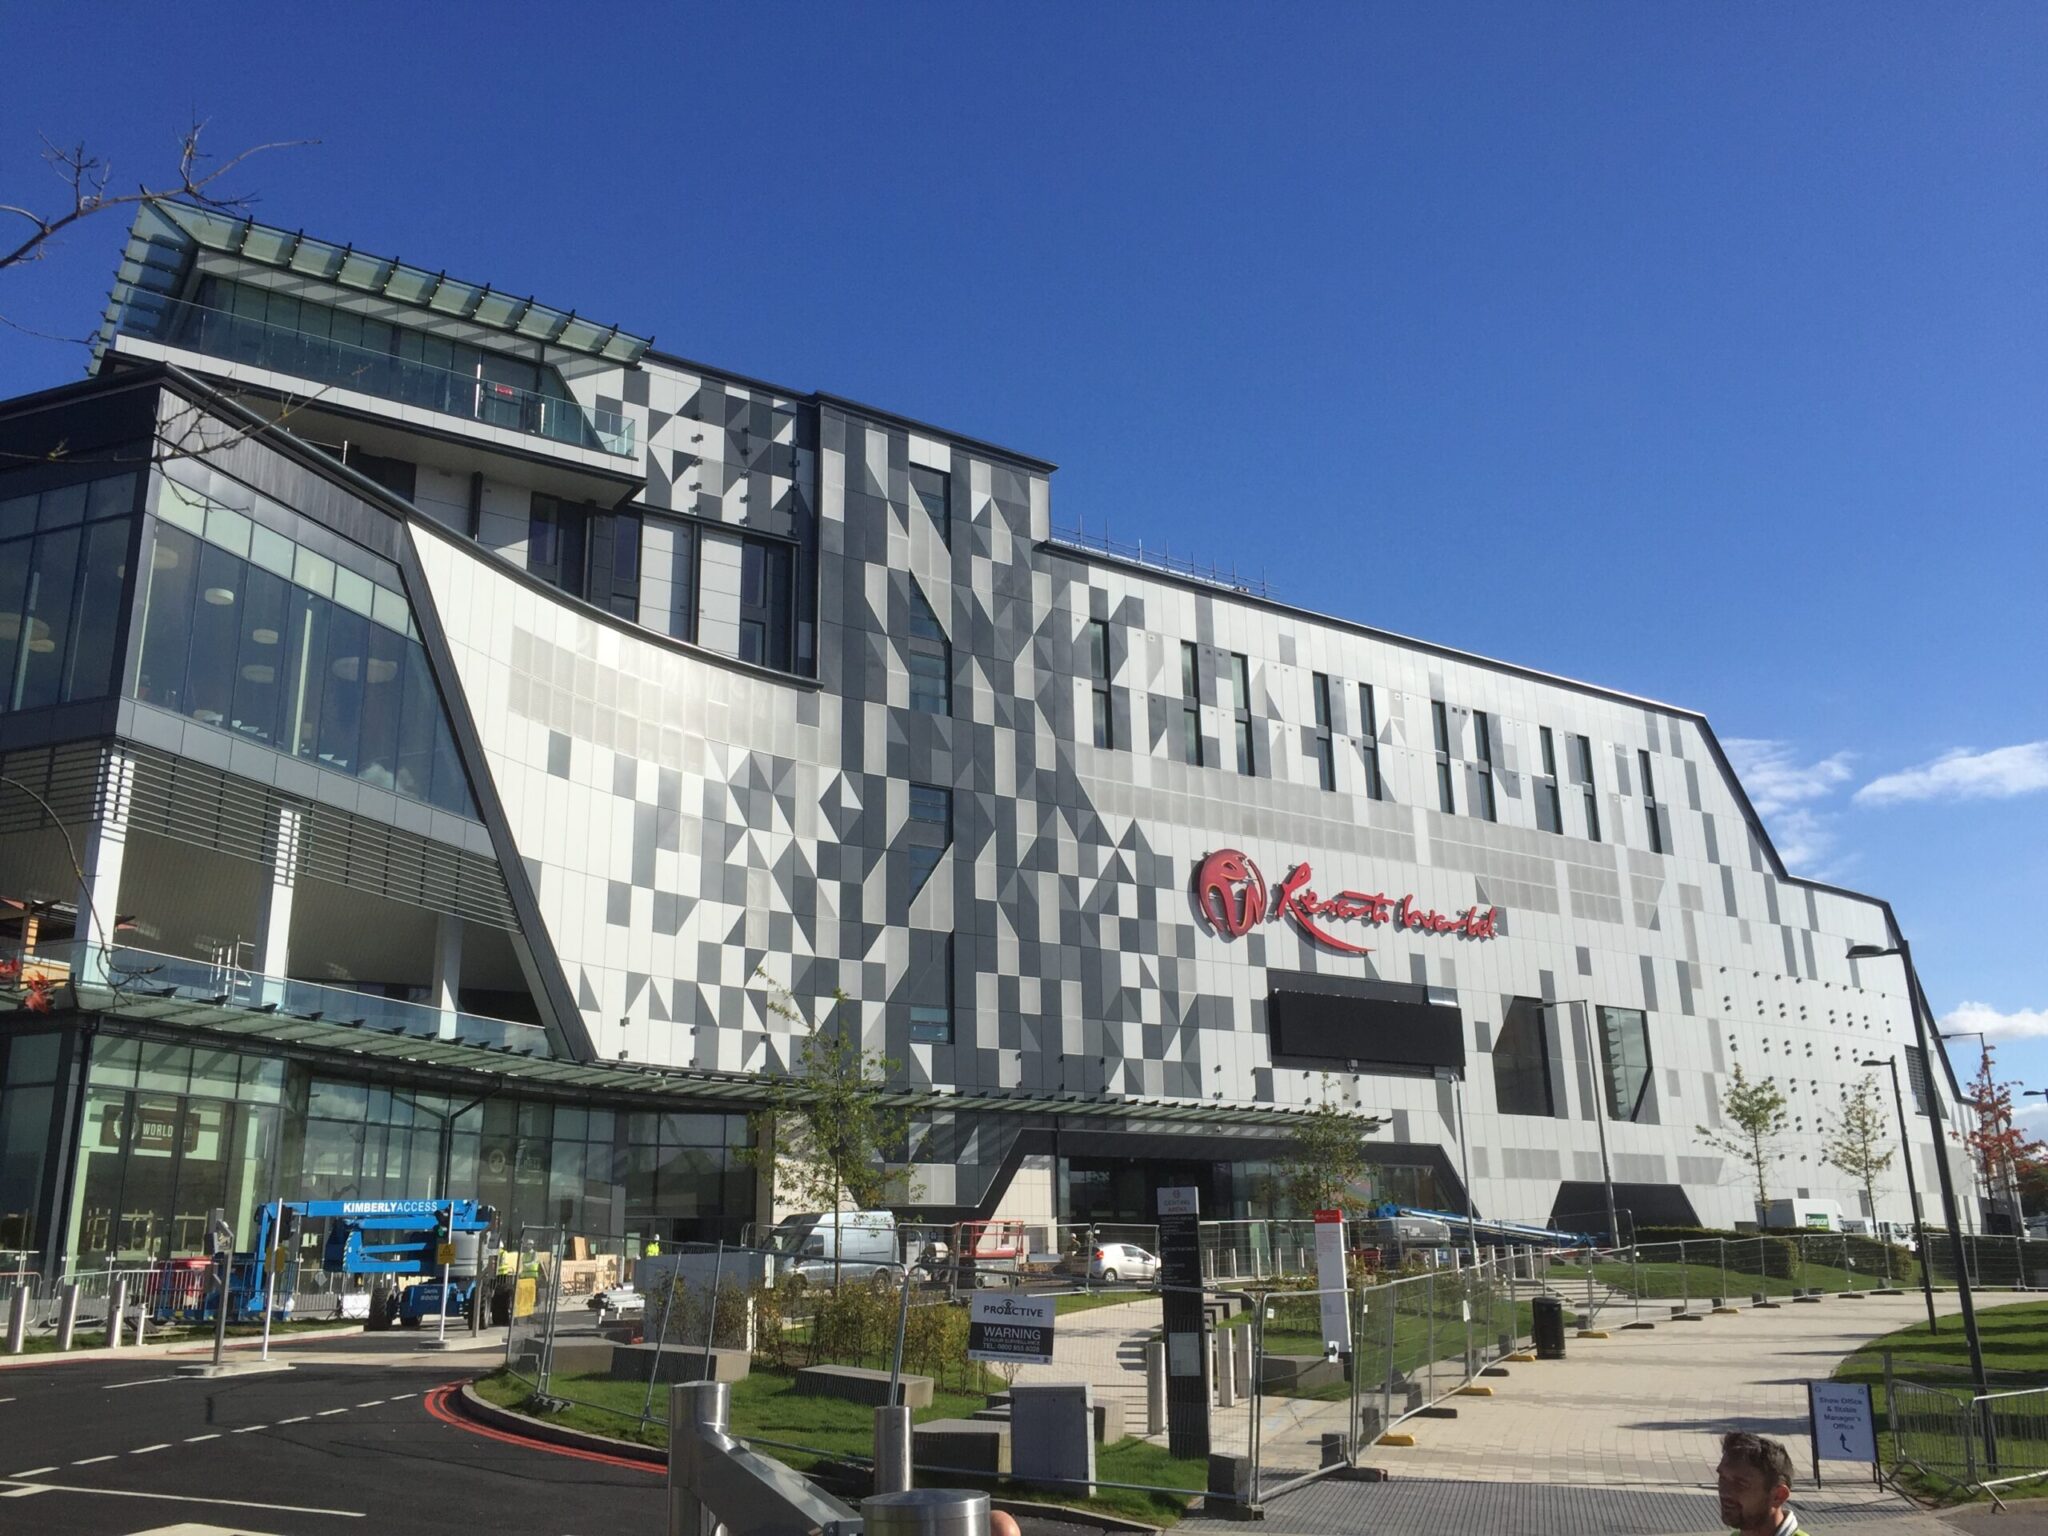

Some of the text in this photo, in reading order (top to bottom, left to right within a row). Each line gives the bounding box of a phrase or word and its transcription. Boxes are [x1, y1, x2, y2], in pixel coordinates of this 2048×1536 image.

[1278, 862, 1497, 953] Resorts World
[142, 1123, 173, 1137] WORLD
[984, 1326, 1040, 1340] WARNING
